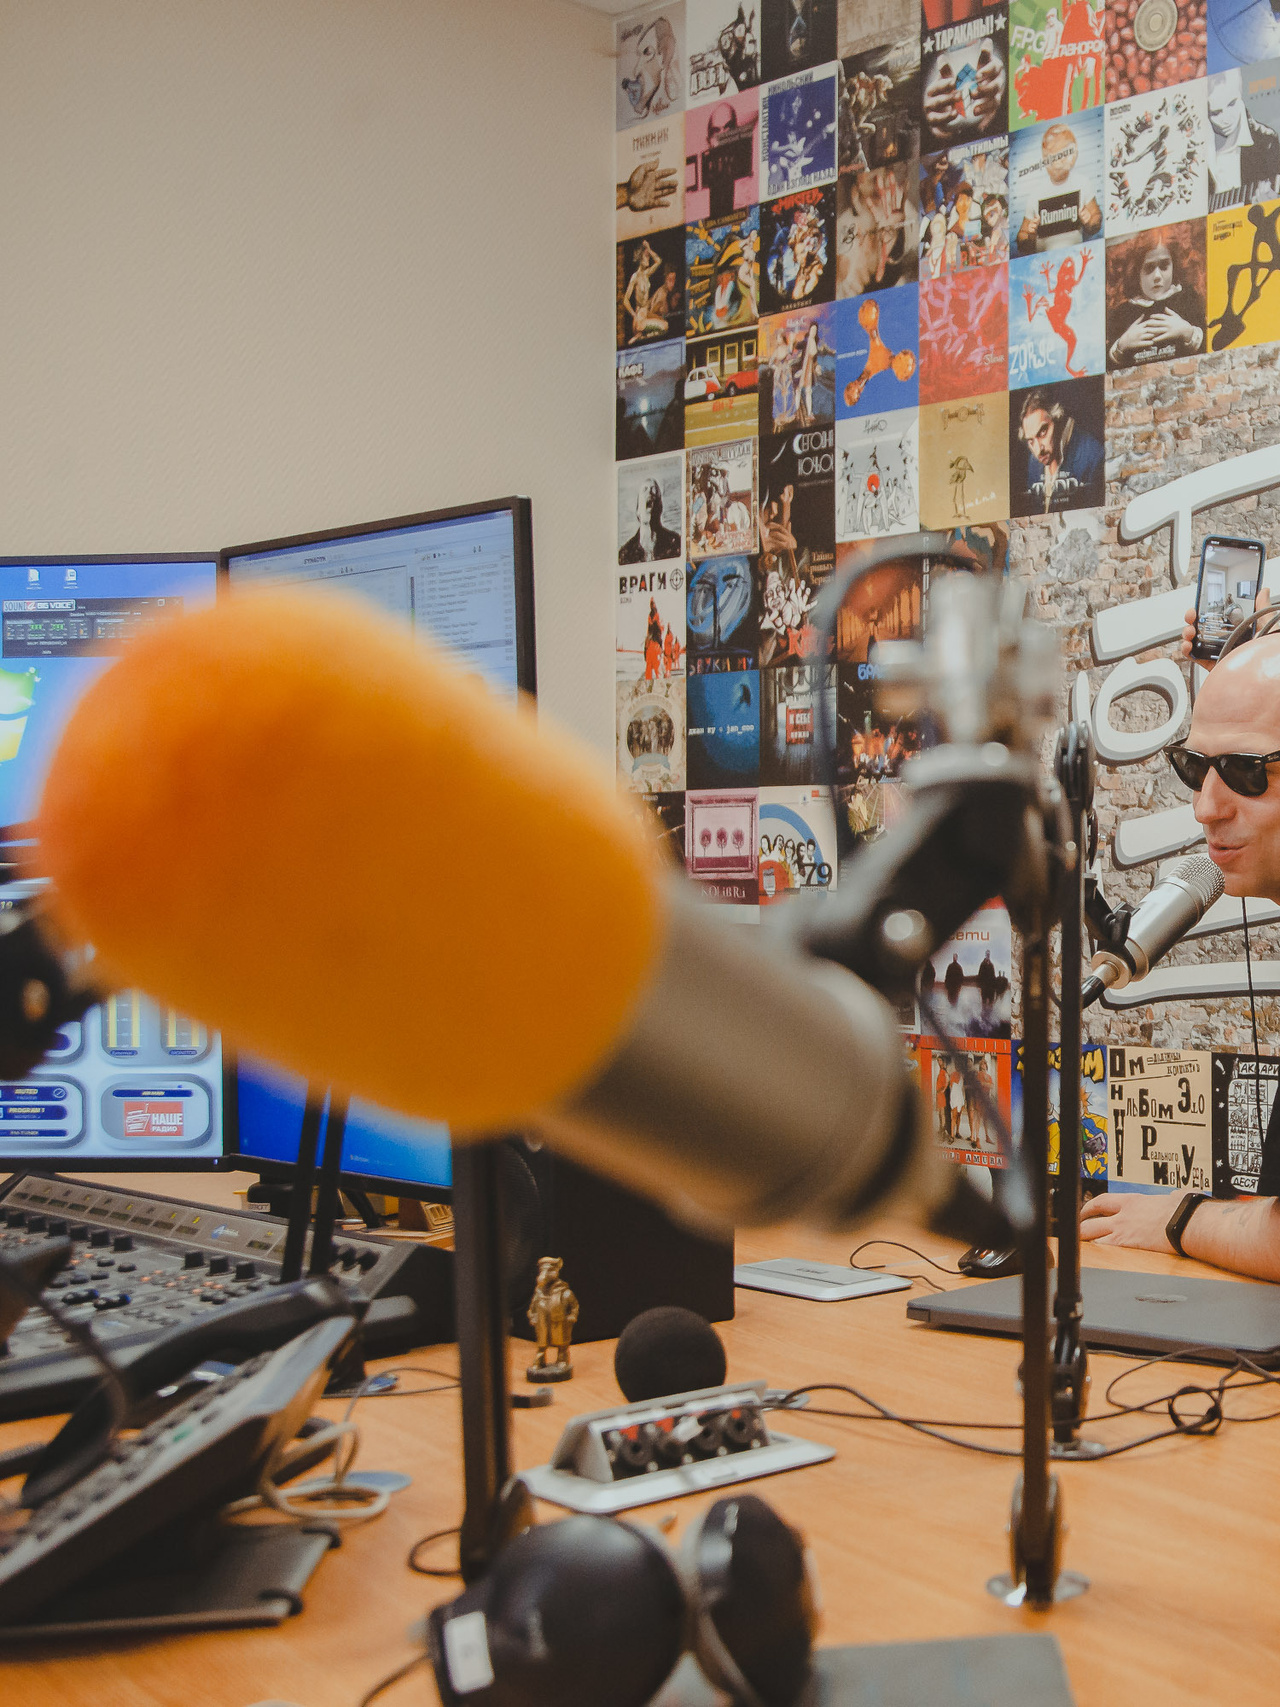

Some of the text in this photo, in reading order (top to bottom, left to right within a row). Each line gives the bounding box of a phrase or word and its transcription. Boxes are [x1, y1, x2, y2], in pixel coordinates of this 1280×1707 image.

[1040, 203, 1078, 226] Running
[619, 570, 667, 595] ВРАГИ
[152, 1113, 184, 1126] НАШЕ
